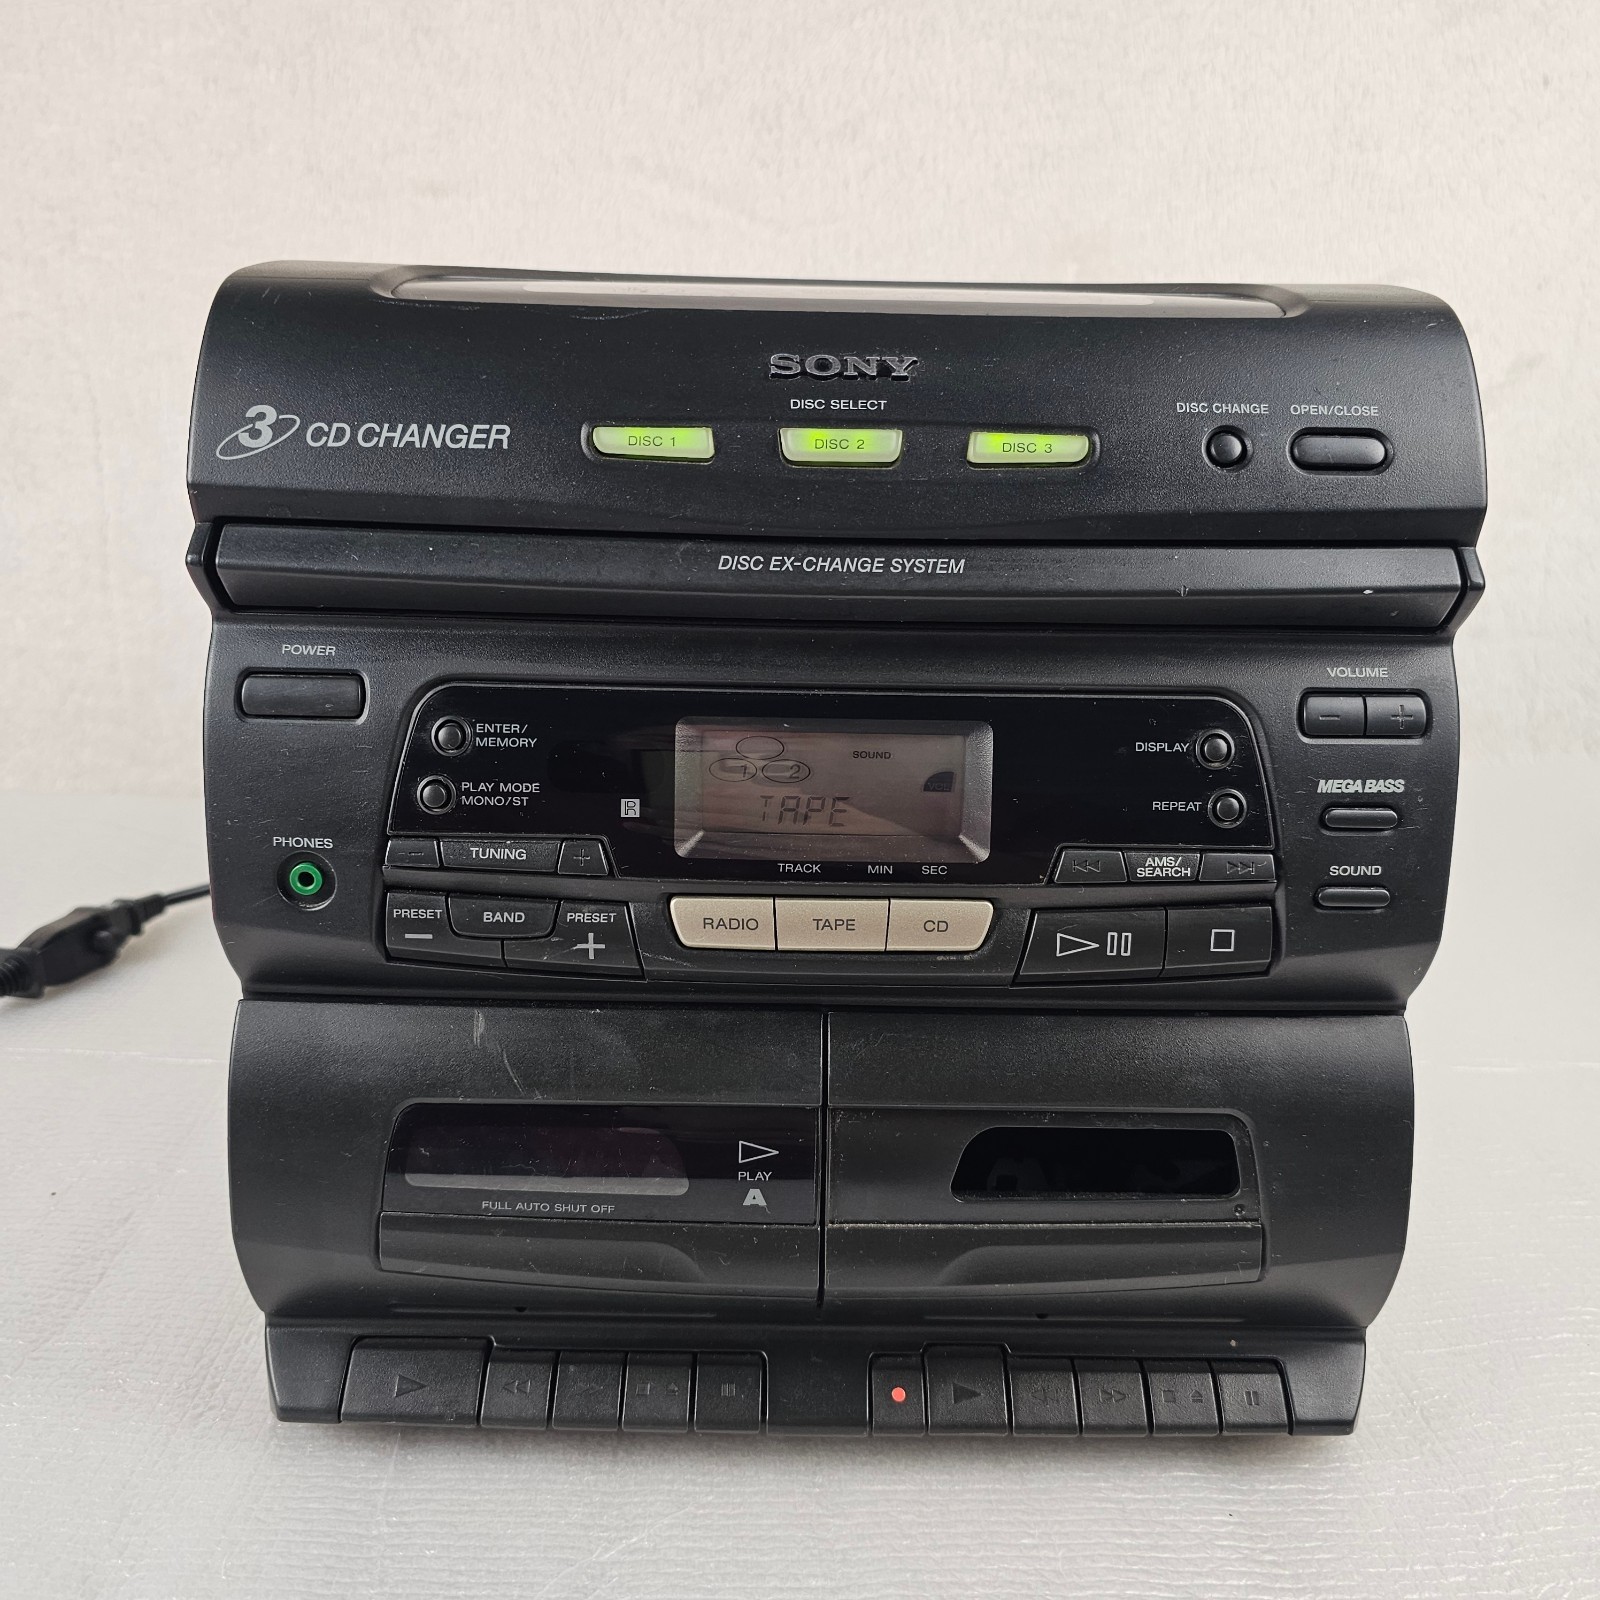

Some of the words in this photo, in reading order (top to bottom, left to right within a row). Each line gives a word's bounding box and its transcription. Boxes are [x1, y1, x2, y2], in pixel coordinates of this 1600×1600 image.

[768, 353, 920, 381] SONY
[789, 398, 825, 410] DISC
[830, 399, 888, 411] SELECT
[1176, 402, 1209, 414] DISC
[1212, 403, 1269, 415] CHANGE
[1290, 404, 1379, 417] OPEN/CLOSE
[306, 422, 351, 448] CD
[357, 423, 511, 450] CHANGER
[627, 435, 664, 448] DISC
[669, 435, 677, 448] 1
[814, 438, 850, 450] DISC
[856, 439, 865, 450] 2
[1002, 442, 1037, 453] DISC
[1044, 442, 1053, 454] 3
[718, 555, 764, 571] DISC
[769, 556, 884, 573] EX-CHANGE
[890, 558, 966, 574] SYSTEM
[281, 644, 336, 656] POWER
[1327, 667, 1389, 679] VOLUME
[476, 723, 528, 735] ENTER/
[475, 737, 538, 749] MEMORY
[1135, 742, 1190, 754] DISPLAY
[852, 751, 892, 760] SOUND
[461, 782, 495, 793] PLAY
[499, 782, 541, 793] MODE
[1317, 779, 1365, 794] MEGA
[1364, 779, 1405, 794] BASS
[461, 796, 529, 808] MONO/ST
[1152, 802, 1202, 812] REPEAT
[760, 795, 850, 827] TAPE
[272, 836, 334, 850] PHONES
[470, 848, 527, 861] TUNING
[778, 863, 822, 873] TRACK
[1145, 856, 1181, 868] AMS/
[867, 864, 893, 875] MIN
[921, 865, 948, 876] SEC
[1136, 867, 1191, 878] SEARCH
[1329, 865, 1382, 877] SOUND
[393, 909, 443, 920] PRESET
[483, 911, 526, 924] BAND
[566, 912, 617, 924] PRESET
[703, 918, 759, 931] RADIO
[813, 919, 856, 931] TAPE
[923, 920, 949, 932] CD
[738, 1171, 772, 1181] PLAY
[742, 1188, 767, 1207] A
[481, 1201, 511, 1211] FULL
[514, 1201, 550, 1212] AUTO
[553, 1203, 587, 1213] SHUT
[591, 1204, 616, 1214] OFF
